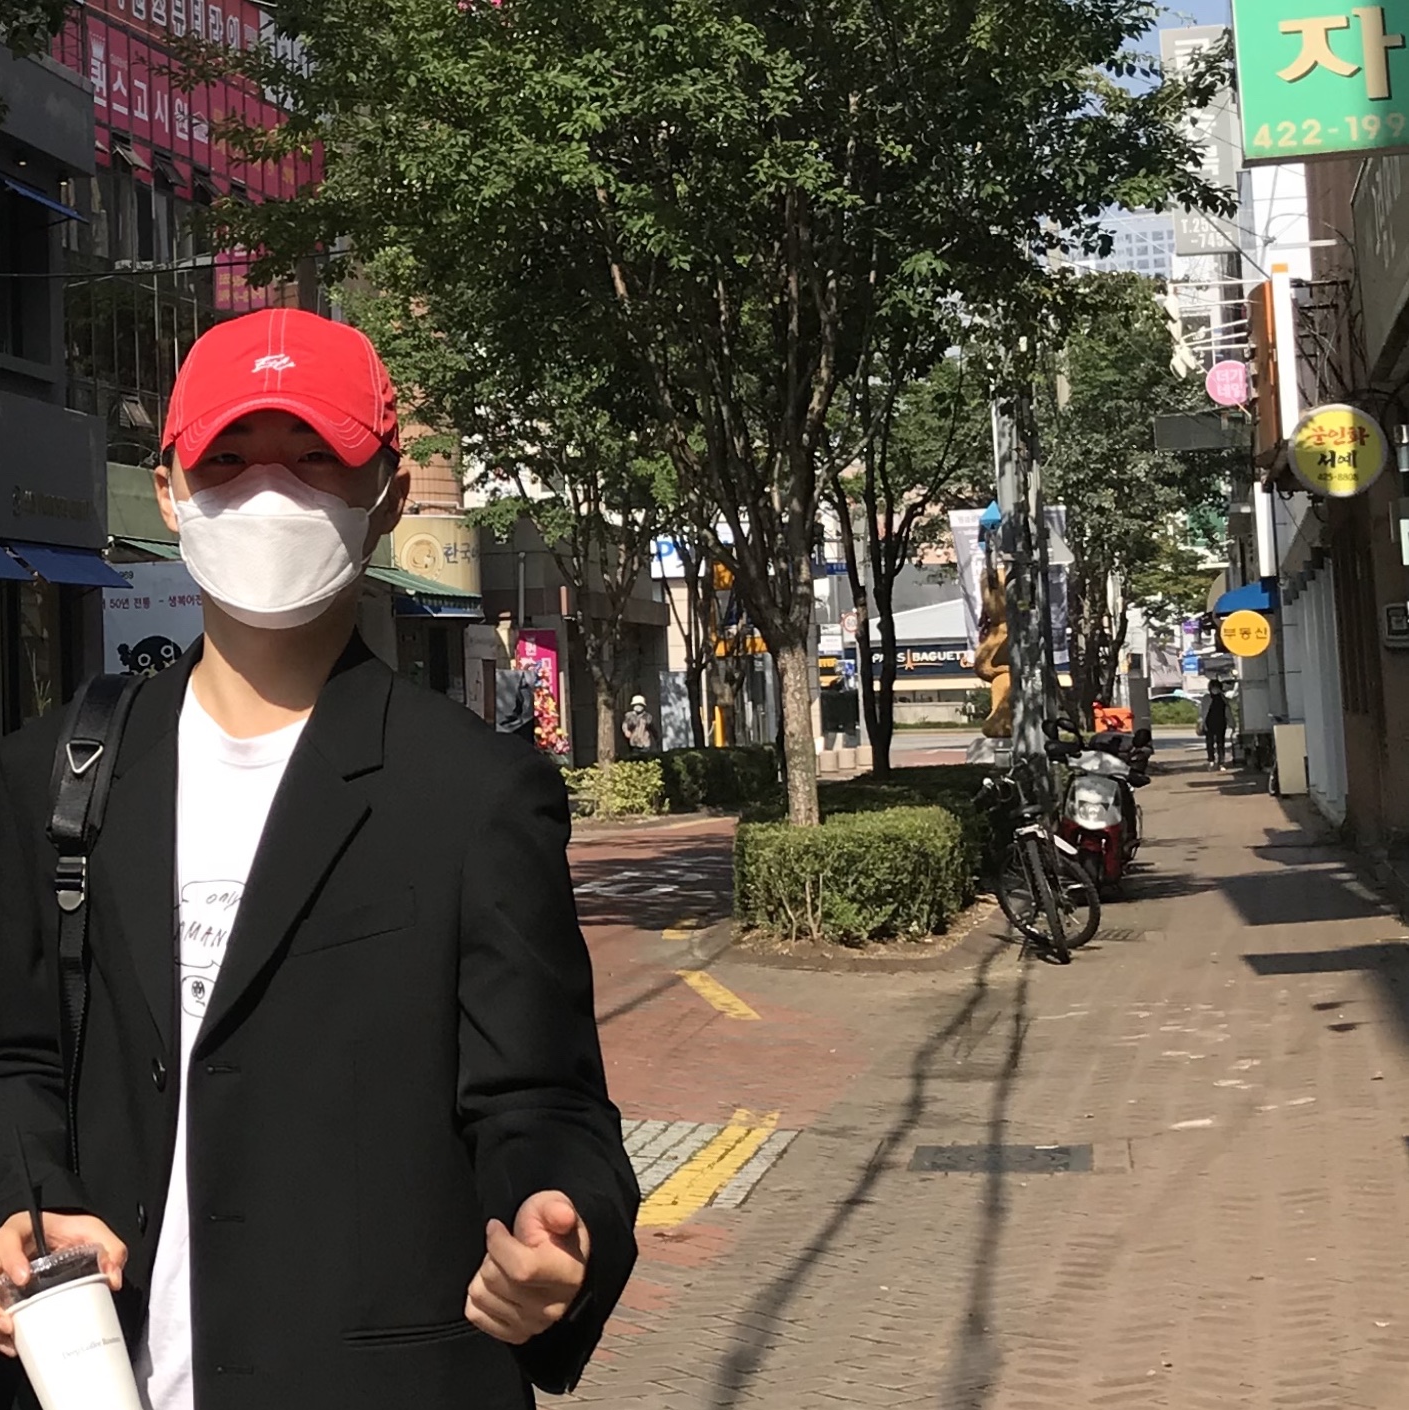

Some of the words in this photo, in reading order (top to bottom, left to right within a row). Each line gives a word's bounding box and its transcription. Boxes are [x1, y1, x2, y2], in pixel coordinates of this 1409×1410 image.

[1275, 6, 1404, 100] 자
[1317, 450, 1358, 469] 서예
[1223, 627, 1268, 640] 부동산
